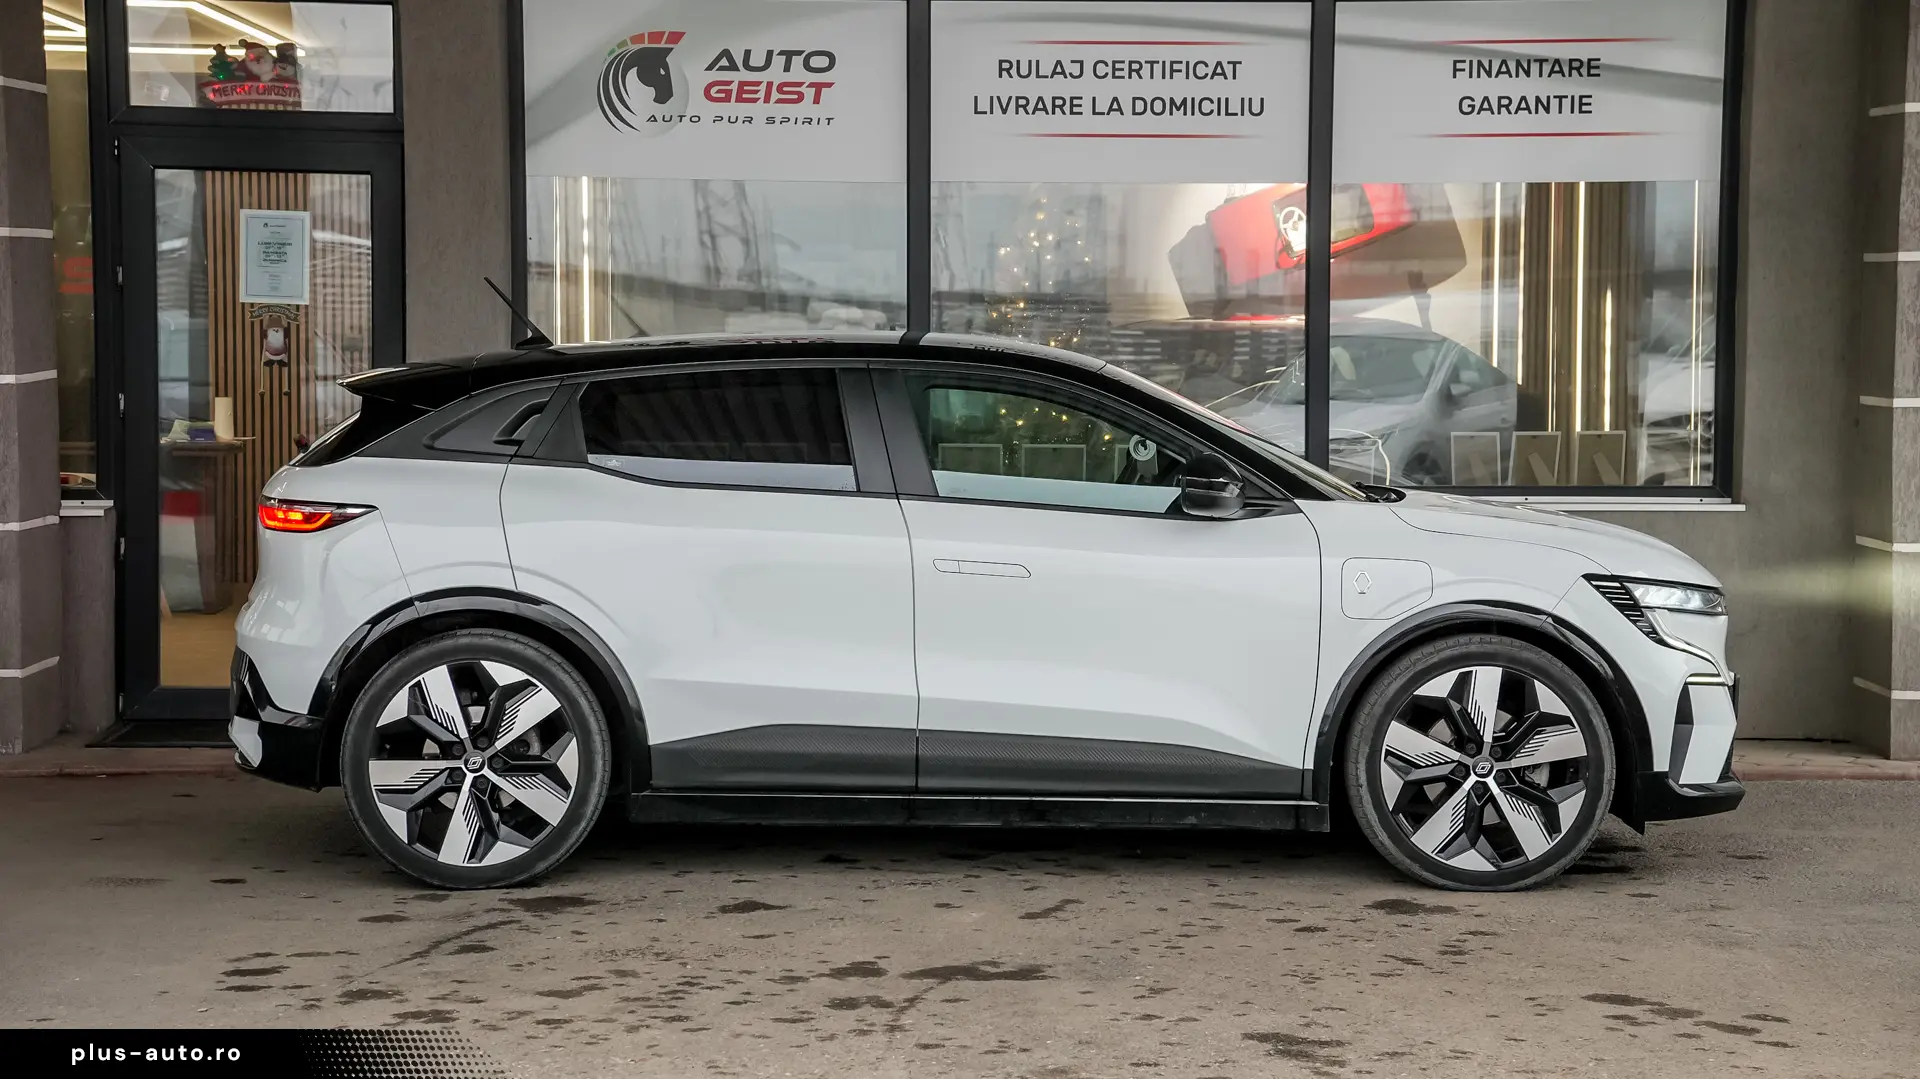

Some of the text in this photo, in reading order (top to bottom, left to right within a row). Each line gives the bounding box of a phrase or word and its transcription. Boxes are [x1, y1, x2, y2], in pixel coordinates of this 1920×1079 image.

[703, 47, 837, 74] AUTO
[997, 58, 1243, 81] RULAJ CERTIFICAT
[1452, 57, 1602, 80] FINANTARE
[212, 84, 254, 99] MERRY
[703, 79, 836, 105] GEIST
[972, 95, 1265, 118] LIVRARE LA DOMICILIU
[1457, 94, 1594, 116] GARANTIE
[645, 114, 836, 126] AUTO PUR SPIRIT
